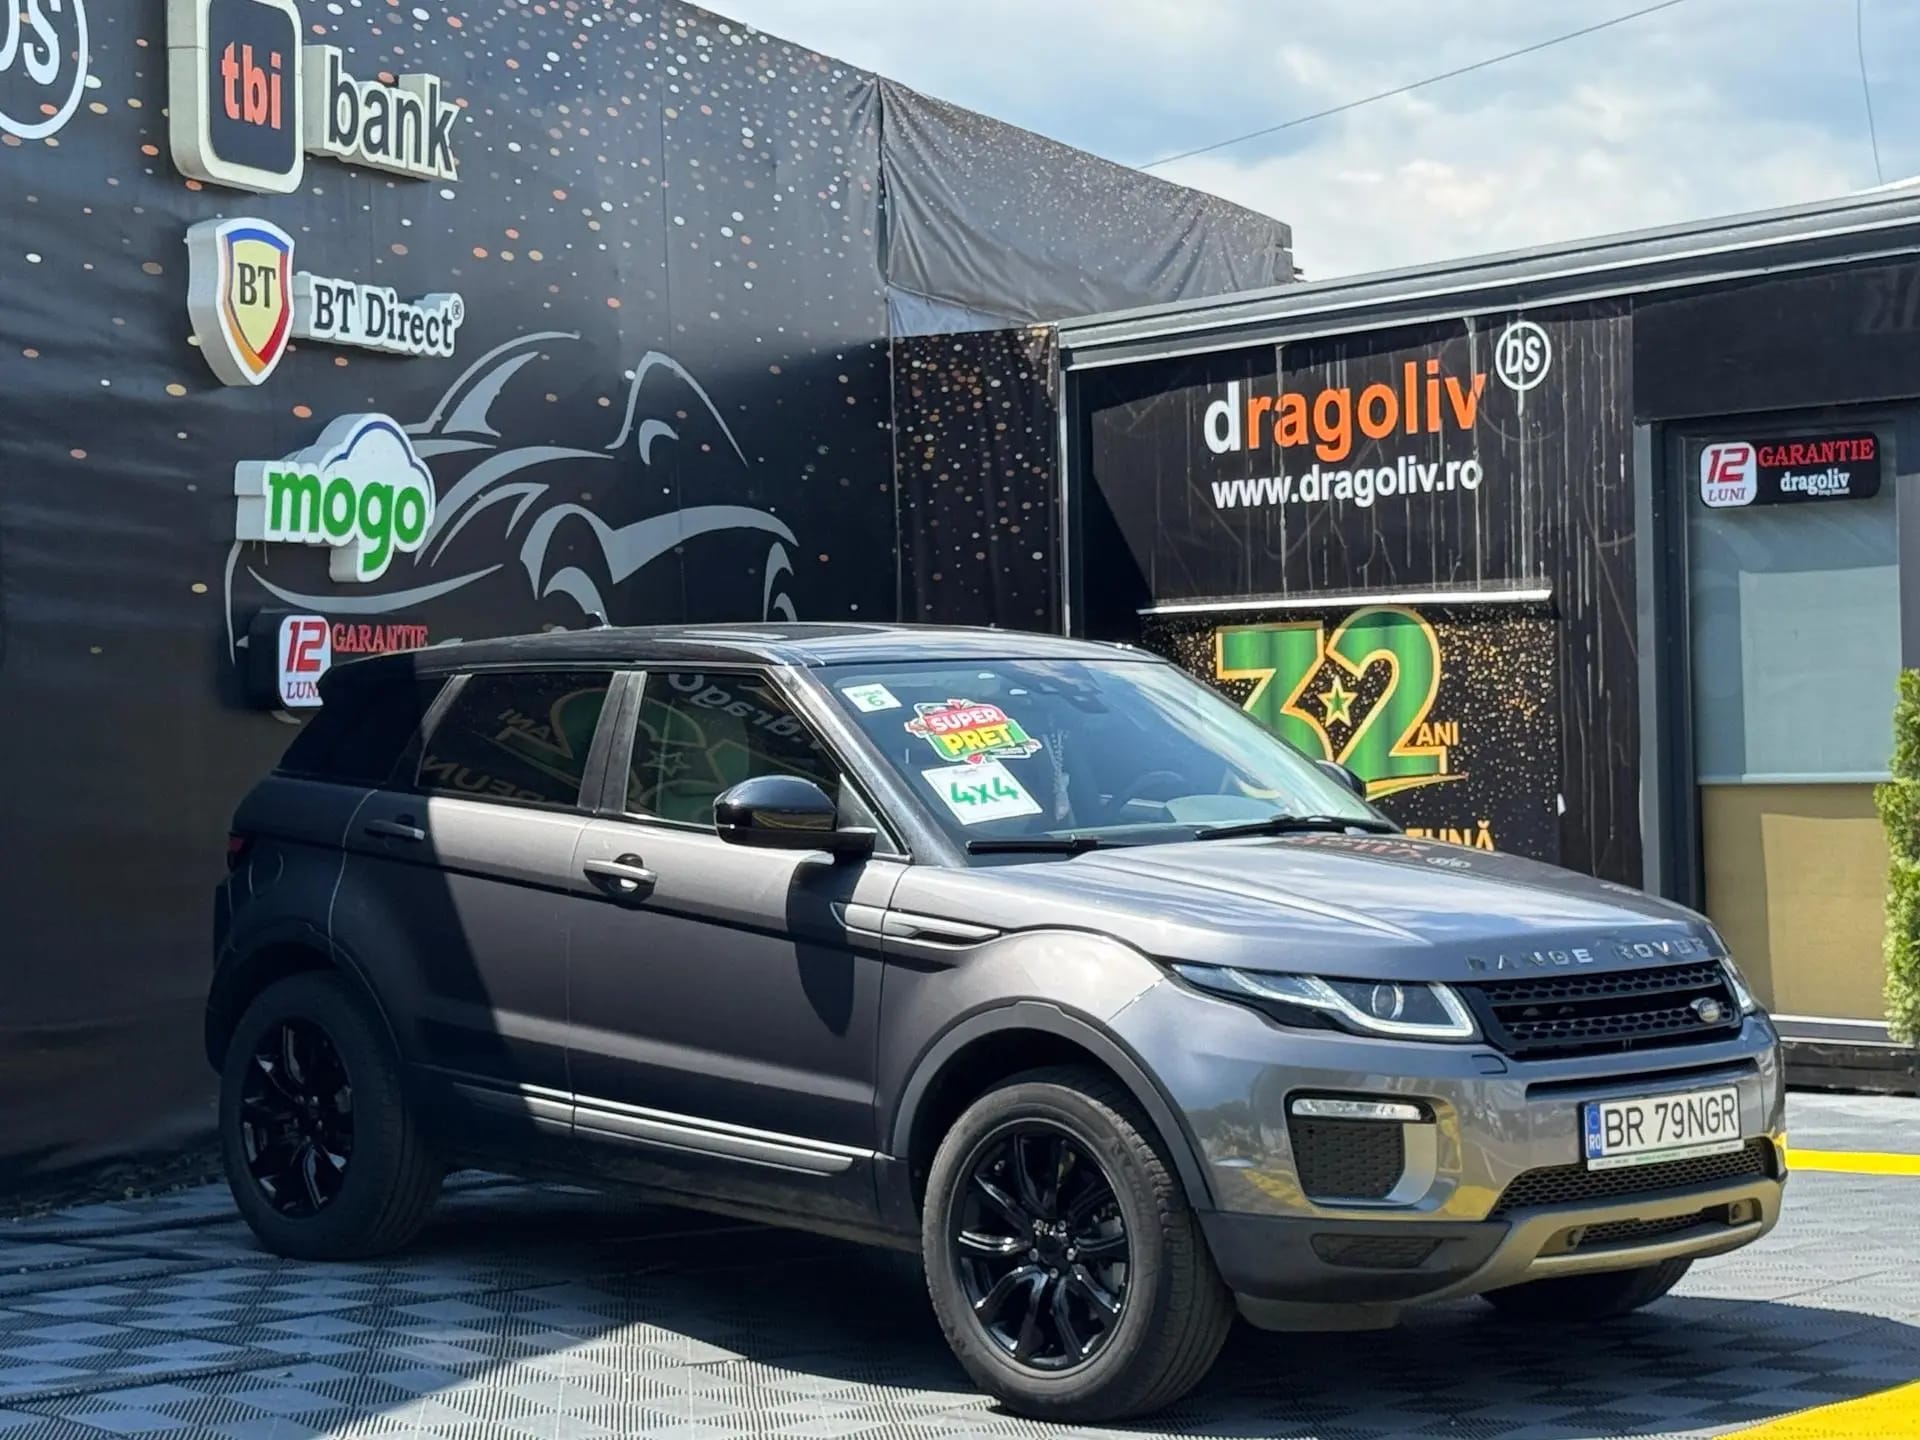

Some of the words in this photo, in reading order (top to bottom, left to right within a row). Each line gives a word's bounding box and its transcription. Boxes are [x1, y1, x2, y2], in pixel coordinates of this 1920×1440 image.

[222, 41, 281, 129] tbi
[329, 54, 456, 178] bank
[237, 262, 276, 308] BT
[314, 284, 355, 334] BT
[1505, 335, 1541, 374] DS
[1203, 359, 1486, 463] dragoliv
[1707, 447, 1749, 484] 12
[1758, 438, 1875, 467] GARANTIE
[1212, 456, 1483, 509] www.dragoliv.ro
[1708, 488, 1747, 502] LUNI
[1780, 468, 1850, 496] dragoliv
[269, 472, 426, 573] mogo
[285, 621, 326, 672] 12
[332, 622, 429, 653] GARANTIE
[286, 681, 322, 699] LUN
[931, 708, 1000, 732] SUPER
[1415, 721, 1459, 746] ANI
[1604, 1107, 1645, 1148] BR
[1654, 1093, 1737, 1144] 79NGR
[1589, 1133, 1602, 1150] RO
